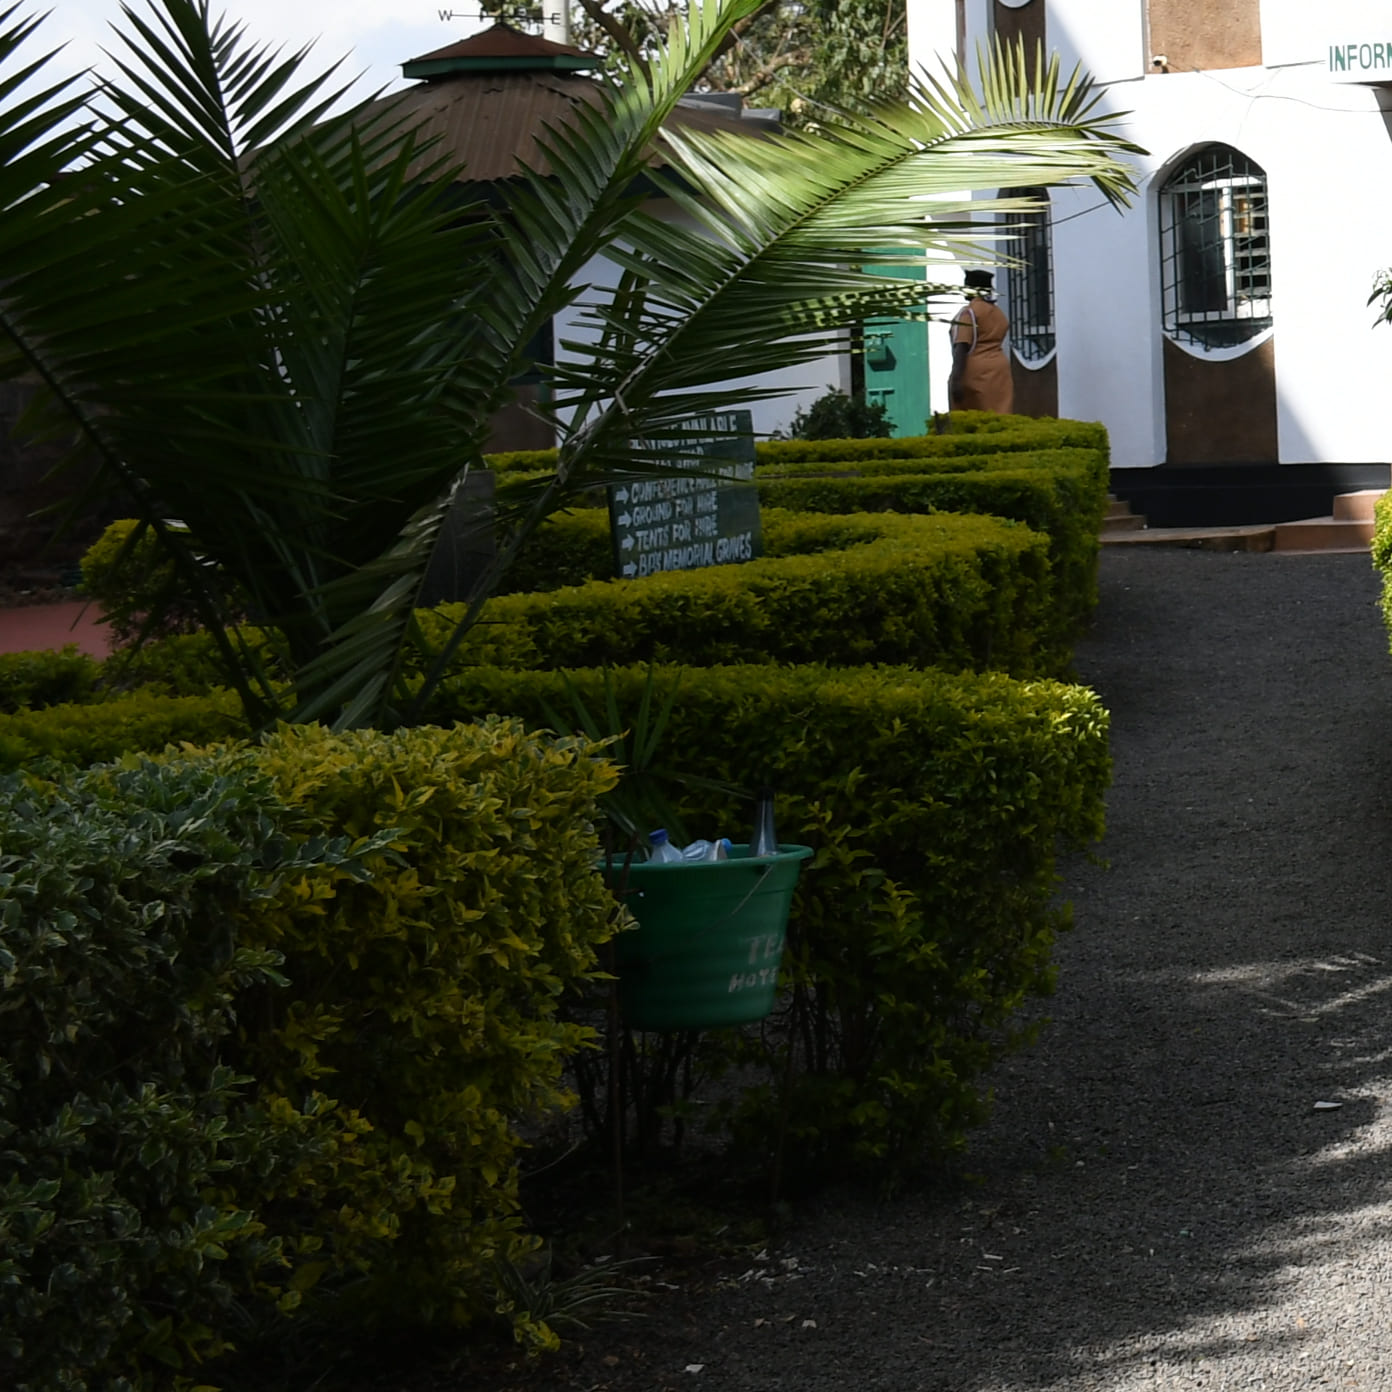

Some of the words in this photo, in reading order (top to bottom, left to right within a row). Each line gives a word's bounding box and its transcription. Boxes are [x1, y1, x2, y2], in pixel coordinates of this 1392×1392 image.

[675, 497, 694, 519] FOR
[635, 526, 670, 551] TENTS
[672, 520, 692, 543] FOR
[663, 542, 714, 571] MEMORIAL
